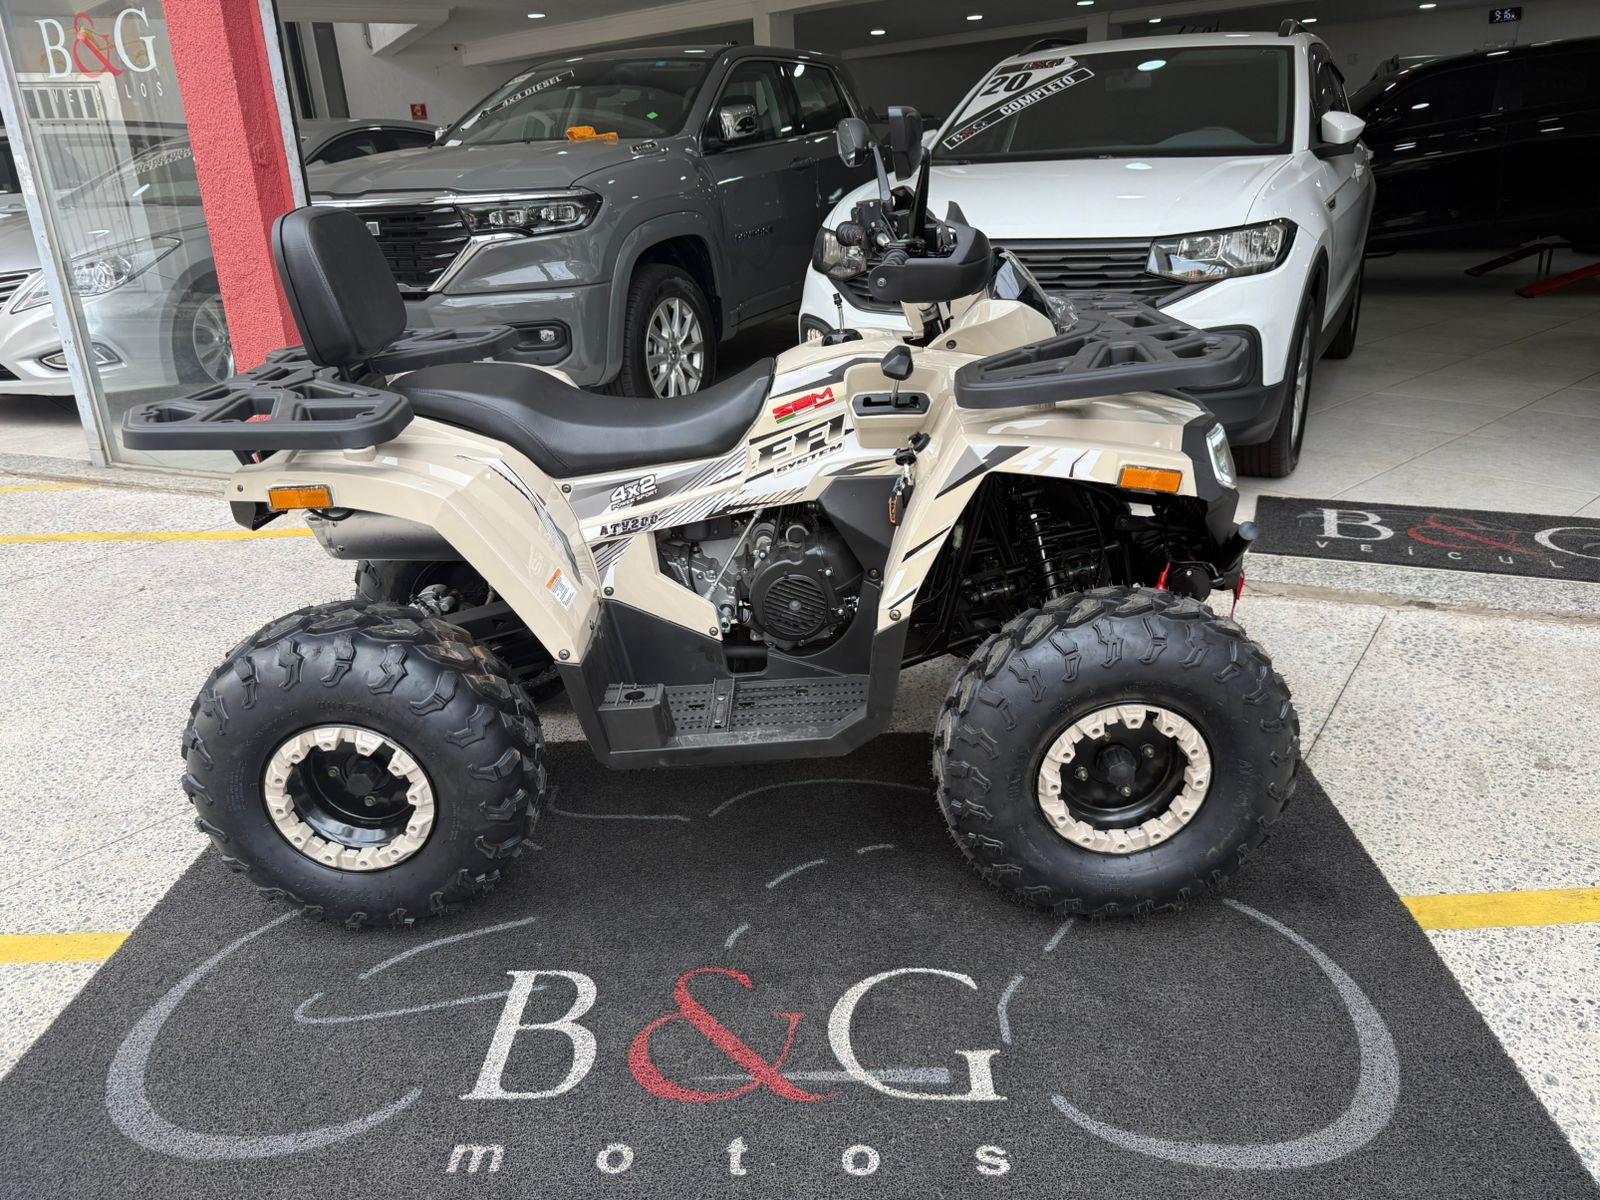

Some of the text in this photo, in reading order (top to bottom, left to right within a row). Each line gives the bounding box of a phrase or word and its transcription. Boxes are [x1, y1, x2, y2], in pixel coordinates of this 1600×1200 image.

[35, 7, 156, 79] B&G
[525, 76, 563, 96] DIESEL
[1000, 76, 1075, 115] COMPLETO
[757, 413, 845, 470] EFI
[459, 967, 1008, 1102] B&G
[446, 1136, 1012, 1177] motos
